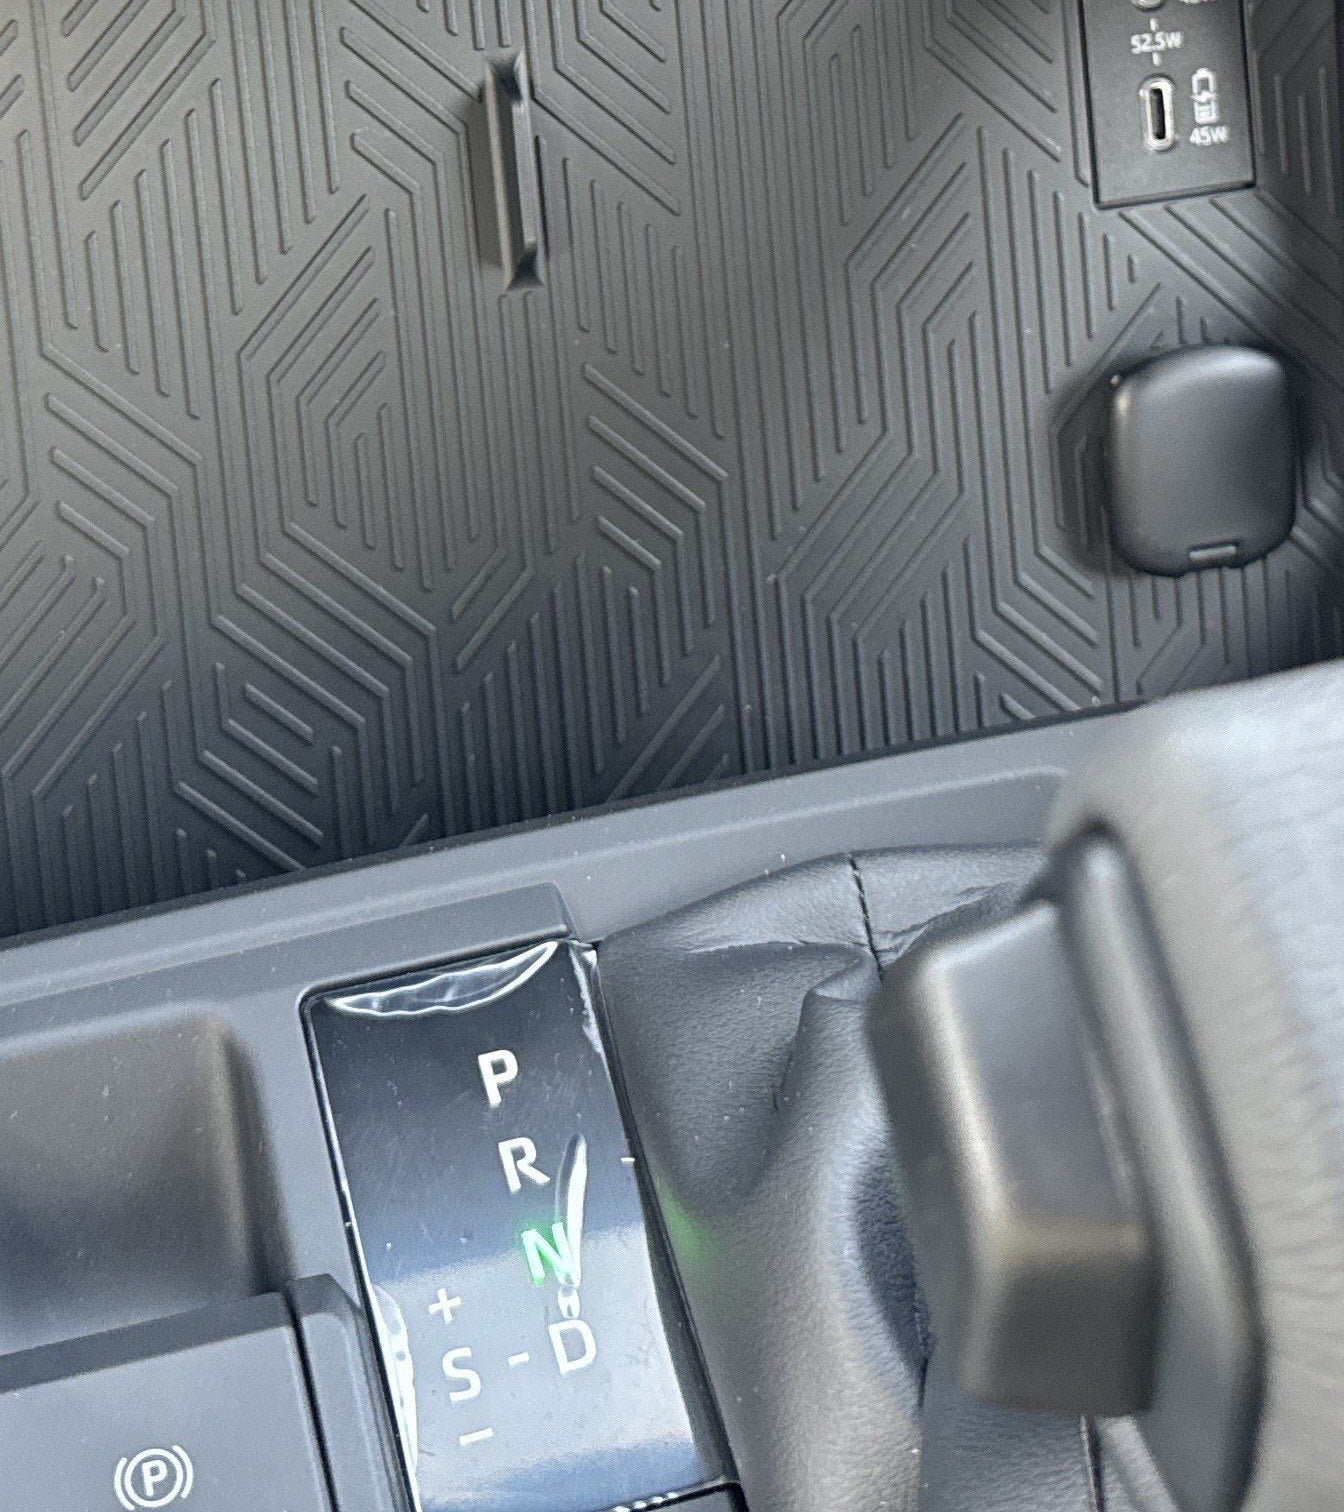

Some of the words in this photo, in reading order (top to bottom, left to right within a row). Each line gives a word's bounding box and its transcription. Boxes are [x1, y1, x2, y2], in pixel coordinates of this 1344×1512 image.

[1189, 125, 1231, 146] 45W
[477, 1049, 518, 1108] P
[498, 1136, 550, 1193] R
[521, 1222, 578, 1285] N
